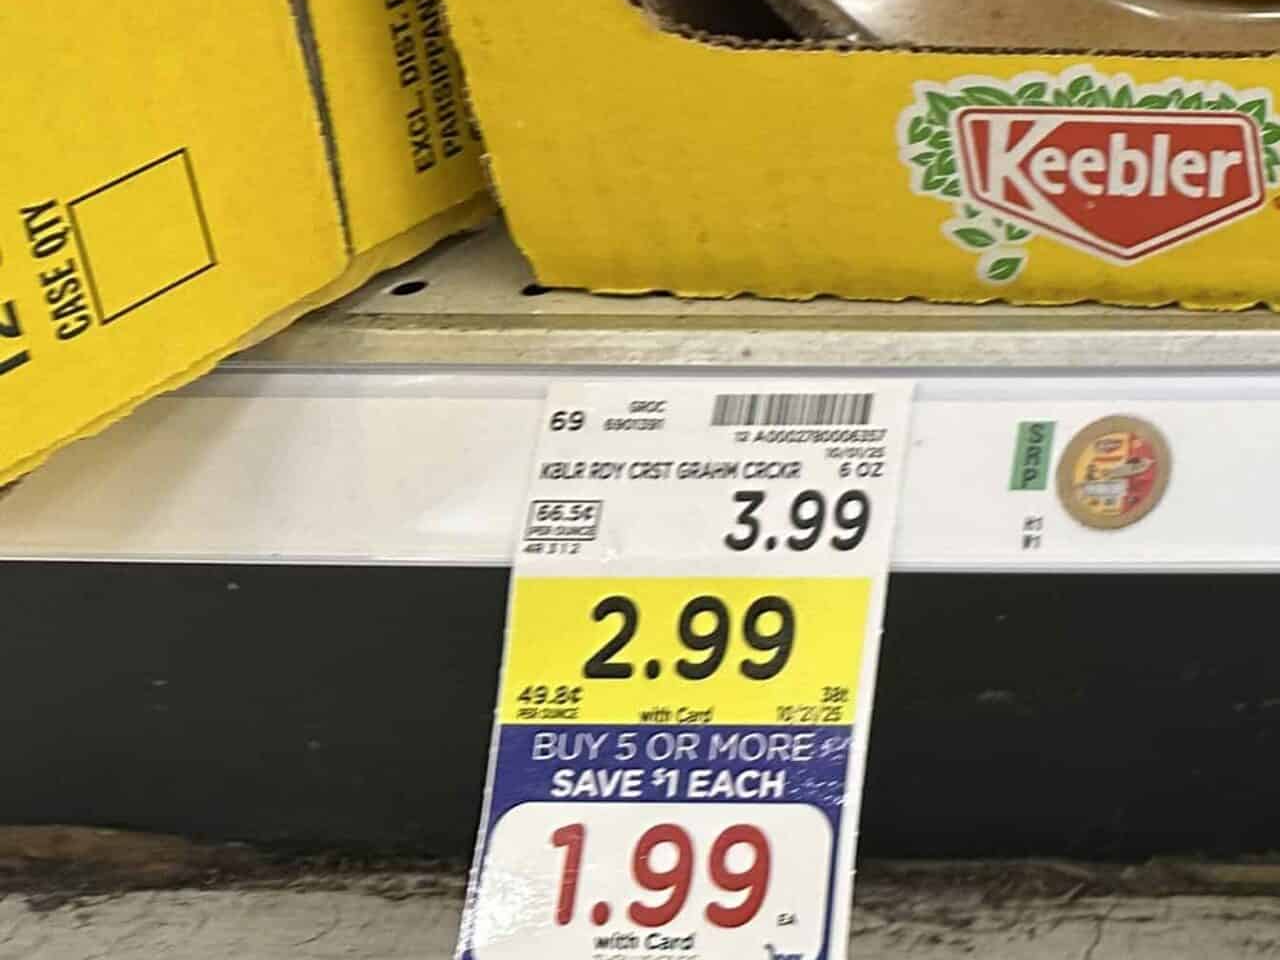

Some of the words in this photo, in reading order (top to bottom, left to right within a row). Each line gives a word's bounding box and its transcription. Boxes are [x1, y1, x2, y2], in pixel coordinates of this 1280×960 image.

[389, 14, 421, 85] DIST.
[402, 91, 436, 170] EXCL.
[985, 115, 1245, 212] Keebler
[19, 198, 72, 259] QTY
[38, 258, 92, 341] CASE
[550, 410, 585, 431] 69
[539, 461, 586, 480] KBLR
[588, 461, 626, 480] RDY
[628, 461, 674, 480] CRST
[676, 461, 739, 480] GRAHM
[742, 461, 802, 480] CRCKR
[839, 462, 854, 478] 6
[856, 461, 885, 478] OZ
[1023, 423, 1044, 489] SRP
[723, 489, 871, 552] 3.99
[583, 595, 797, 682] 2.99
[517, 687, 583, 705] 49.8¢
[640, 707, 674, 723] with
[677, 705, 715, 724] Card
[532, 732, 602, 761] BUY
[613, 733, 638, 760] 5
[646, 733, 698, 761] OR
[707, 732, 817, 761] MORE
[550, 769, 644, 797] SAVE
[651, 768, 677, 797] $1
[687, 770, 787, 798] EACH
[551, 823, 772, 929] 1.99
[592, 931, 640, 951] with
[643, 931, 697, 951] Card
